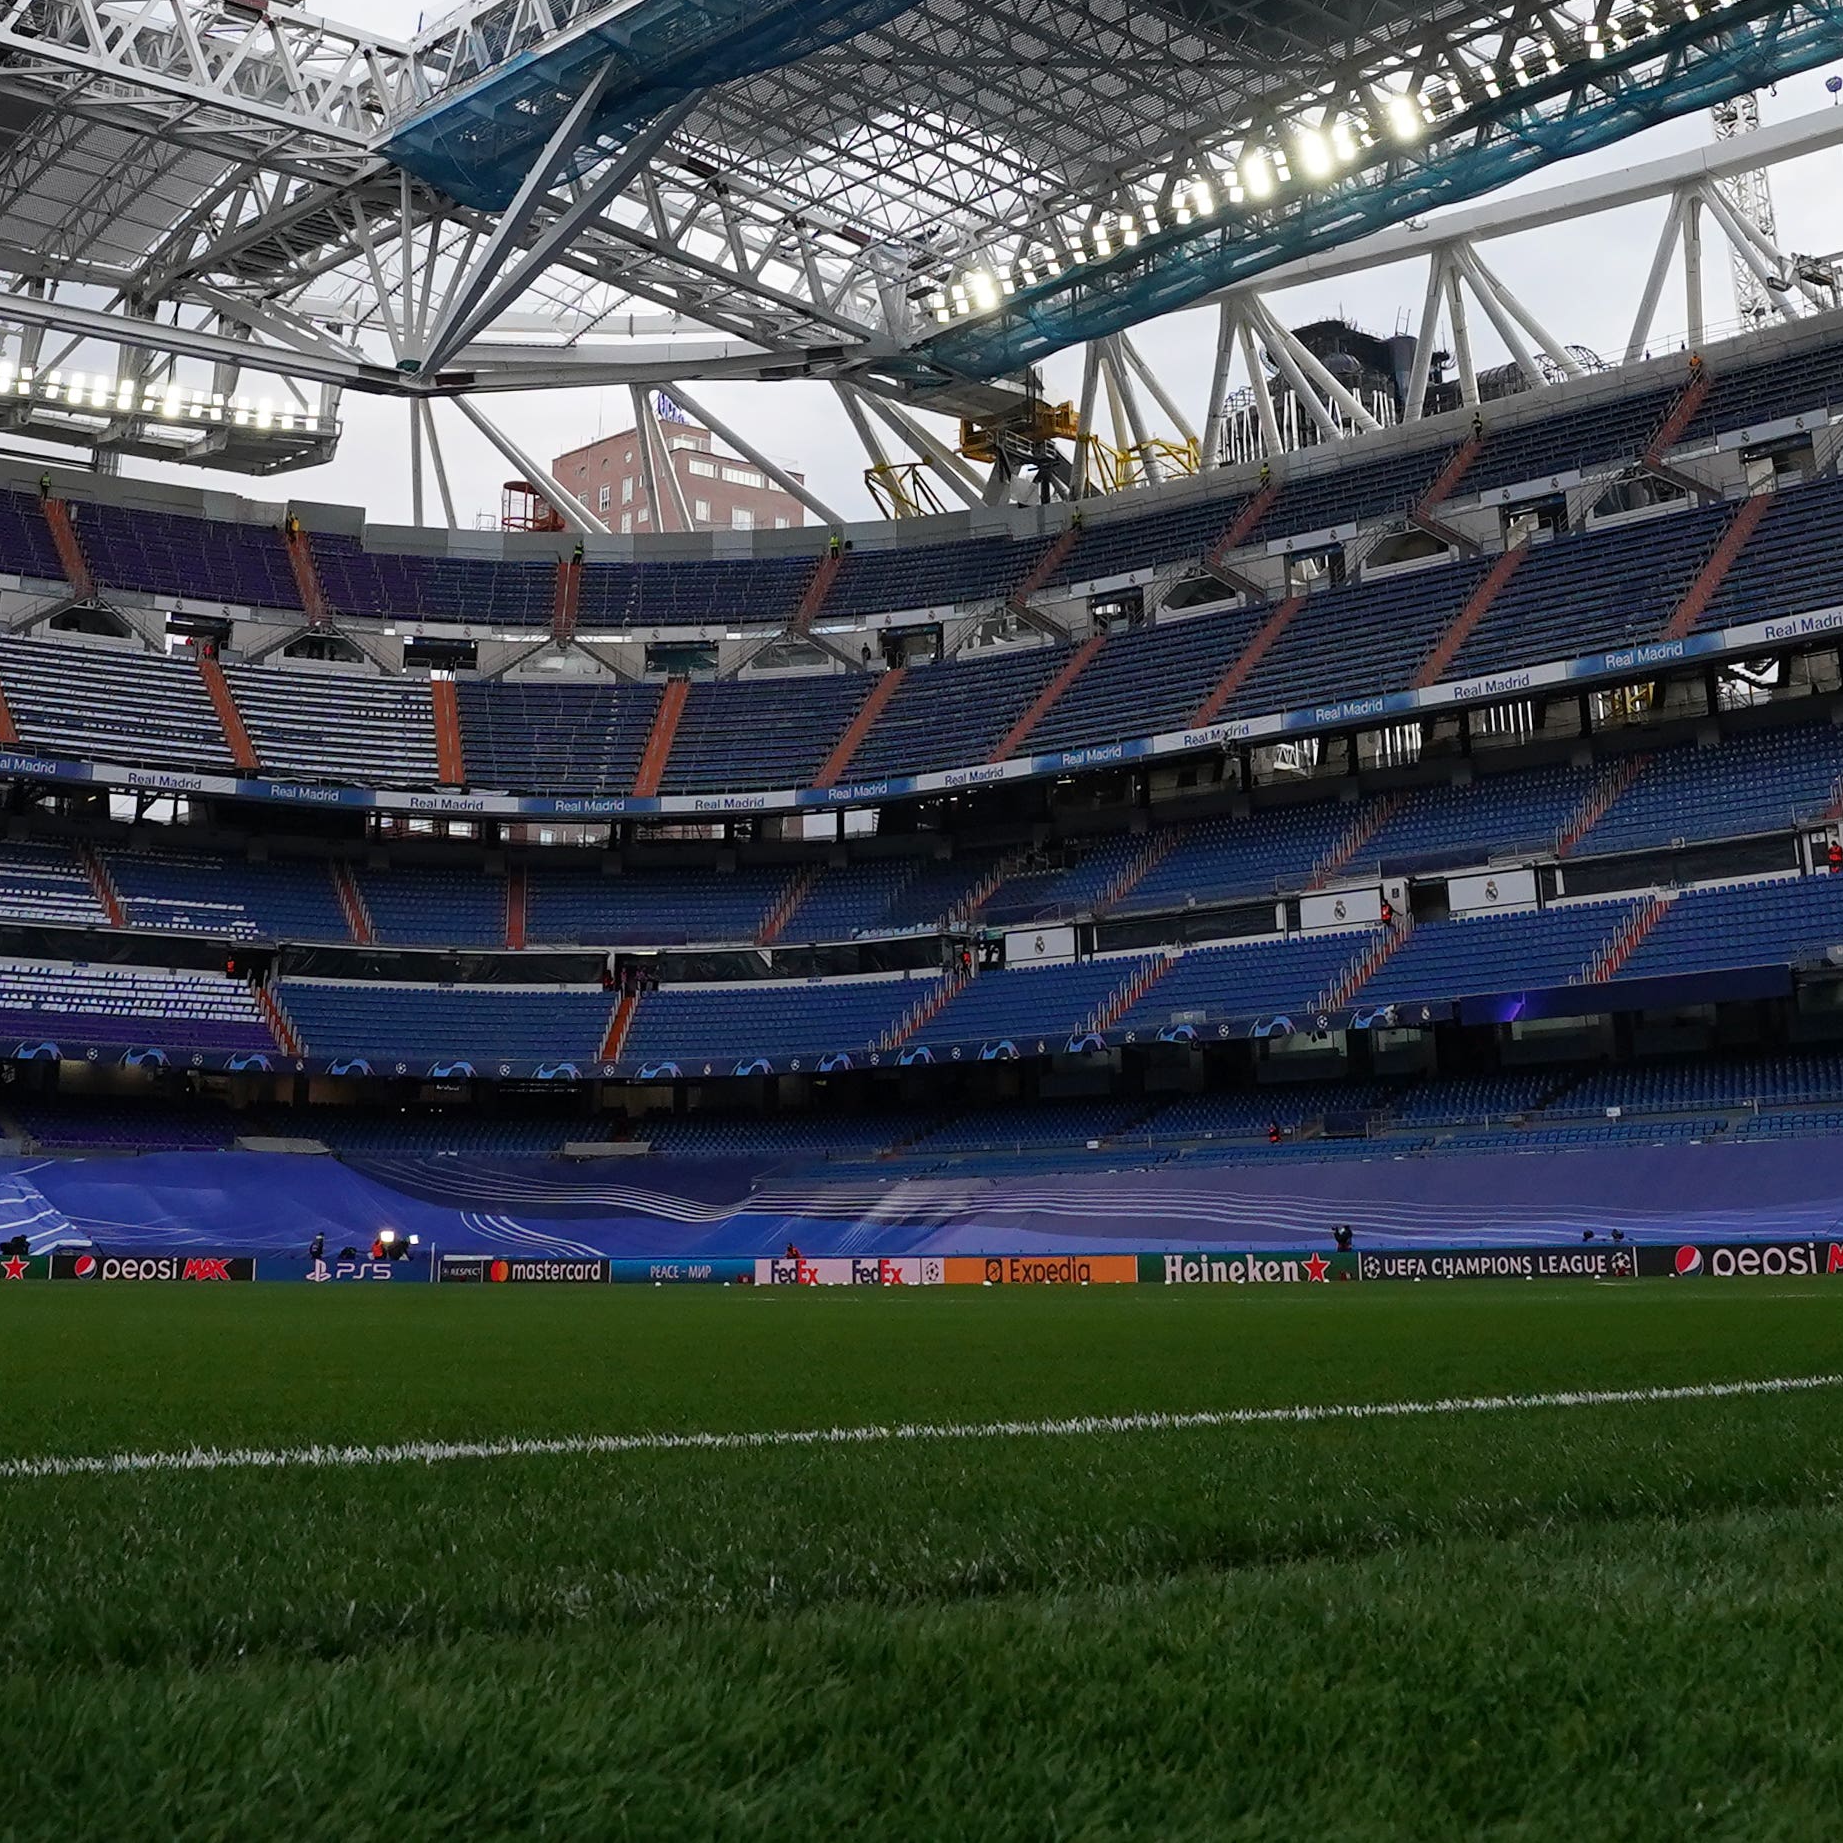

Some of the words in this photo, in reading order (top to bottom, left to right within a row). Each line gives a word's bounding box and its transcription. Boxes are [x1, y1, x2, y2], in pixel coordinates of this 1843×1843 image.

[1765, 621, 1797, 638] Real
[1605, 649, 1634, 669] Real
[1637, 642, 1683, 662] Madrid
[1454, 683, 1481, 698] Real
[1486, 674, 1529, 693] Madrid
[1315, 706, 1340, 722] Real
[1344, 699, 1382, 717] Madrid
[1184, 733, 1208, 745] Real
[14, 758, 56, 773] Madrid
[1062, 753, 1084, 766] Real
[1087, 746, 1121, 762] Madrid
[128, 773, 155, 785] Real
[159, 775, 201, 789] Madrid
[945, 773, 966, 785] Real
[970, 767, 1003, 780] Madrid
[270, 785, 297, 798] Real
[299, 787, 340, 801] Madrid
[828, 787, 852, 799] Real
[853, 781, 887, 796] Madrid
[410, 798, 437, 809] Real
[442, 799, 483, 811] Madrid
[555, 799, 581, 811] Real
[585, 798, 624, 811] Madrid
[695, 799, 721, 810] Real
[724, 796, 764, 808] Madrid
[1166, 1254, 1300, 1282] Heineken
[1385, 1256, 1426, 1275] UEFA
[1432, 1256, 1532, 1274] CHAMPIONS
[1540, 1255, 1606, 1273] LEAGUE
[1713, 1242, 1816, 1275] pepsi
[103, 1257, 176, 1280] pepsi
[182, 1258, 233, 1280] MAX
[336, 1263, 391, 1280] PS5
[512, 1260, 601, 1281] mastercard
[651, 1265, 679, 1279] PEACE
[688, 1265, 710, 1279] МИР
[771, 1260, 818, 1284] FedEx
[852, 1260, 902, 1284] FedEx
[1011, 1258, 1090, 1283] Expedia
